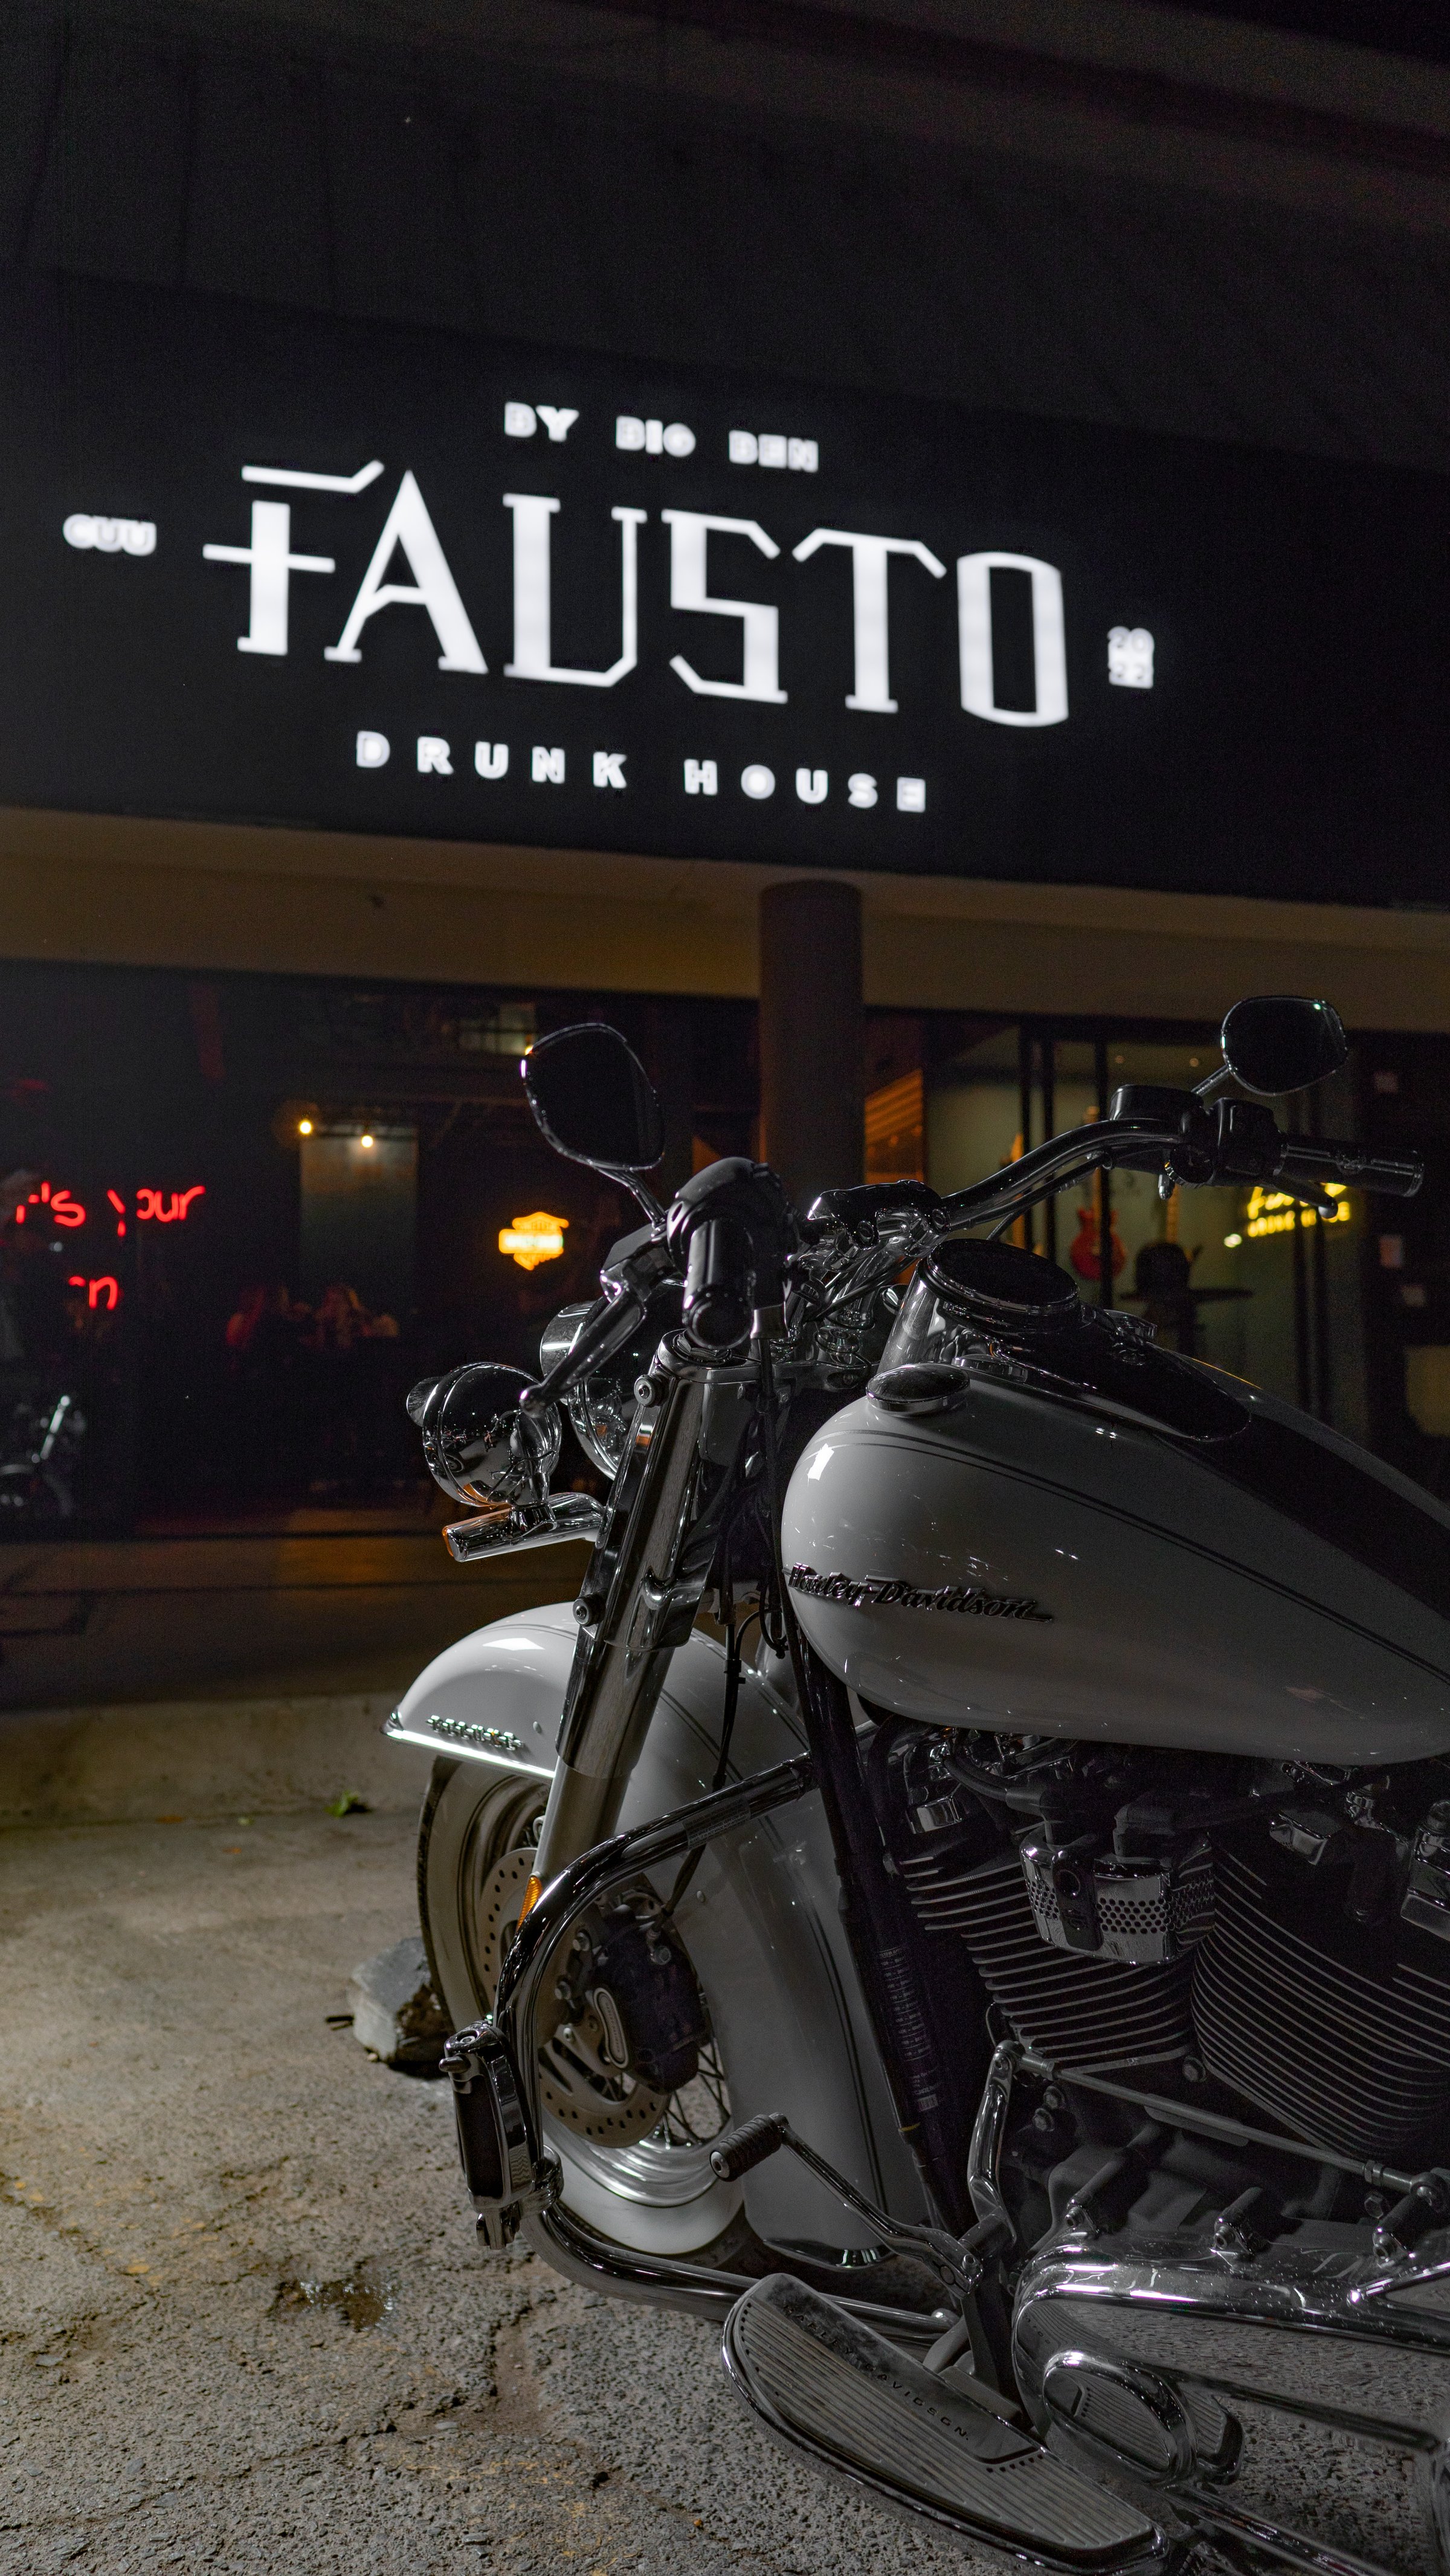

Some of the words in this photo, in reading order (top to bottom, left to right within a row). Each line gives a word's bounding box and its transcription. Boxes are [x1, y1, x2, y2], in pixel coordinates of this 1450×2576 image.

[503, 401, 580, 442] BY
[615, 415, 697, 457] BIG
[728, 429, 819, 472] BEN
[62, 513, 158, 557] CUU
[202, 460, 1069, 728] FAUSTO
[355, 730, 628, 789] DRUNK
[683, 758, 927, 814] HOUSE
